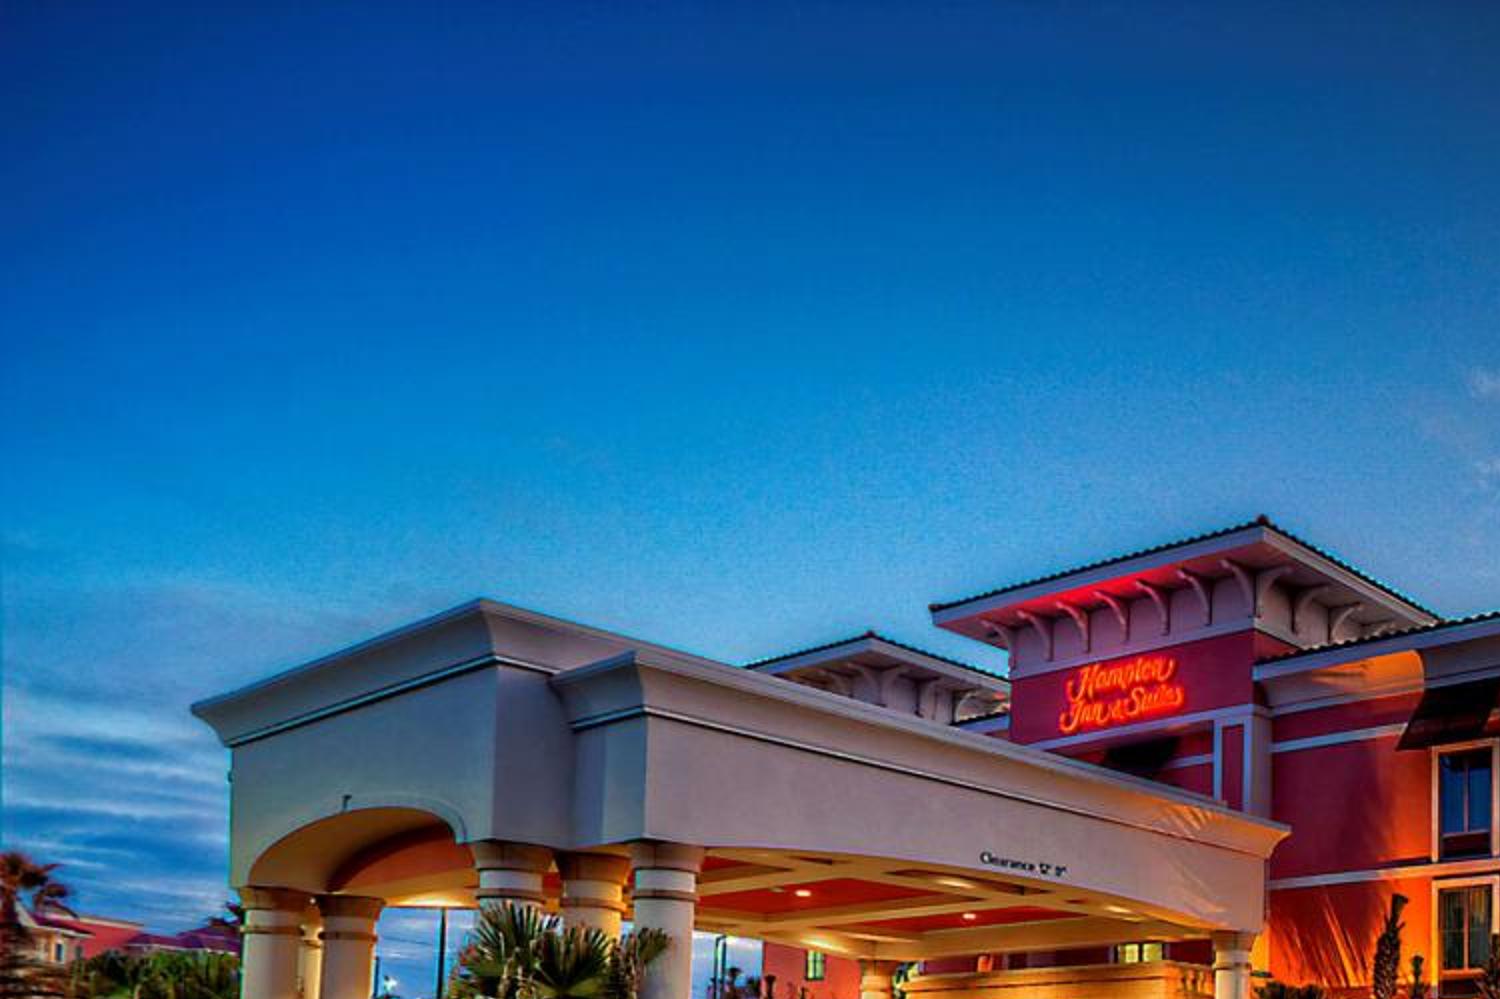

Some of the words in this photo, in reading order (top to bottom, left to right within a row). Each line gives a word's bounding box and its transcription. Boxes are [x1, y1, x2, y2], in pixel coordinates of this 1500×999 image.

[1067, 657, 1175, 701] Hampton
[1060, 700, 1112, 733] Inn
[1125, 686, 1183, 716] Suites
[980, 850, 1035, 871] Clearance
